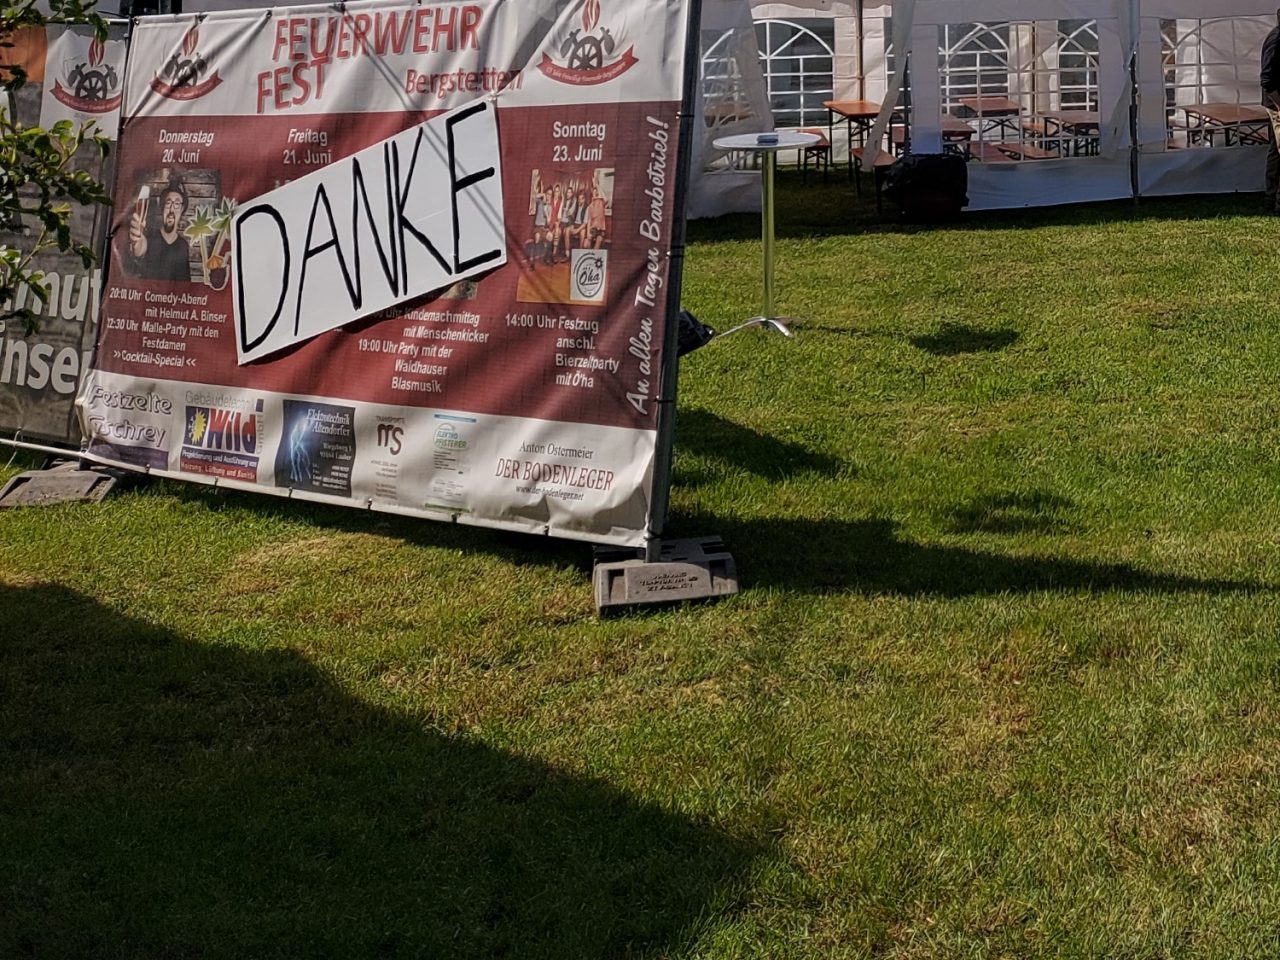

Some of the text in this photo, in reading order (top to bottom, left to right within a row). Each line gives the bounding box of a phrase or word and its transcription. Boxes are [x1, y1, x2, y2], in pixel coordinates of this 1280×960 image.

[272, 5, 485, 62] FEUERWEHR
[257, 56, 332, 114] FEST
[404, 67, 525, 98] Bergstetten
[159, 129, 214, 147] Donnerstag
[287, 128, 328, 145] Freitag
[553, 121, 606, 141] Sonntag
[162, 149, 200, 163] 20. Juni
[283, 150, 332, 165] 21. Juni
[553, 144, 603, 162] 23. Juni
[236, 102, 502, 353] DANKE
[626, 116, 669, 415] An allen Tagen Barbetrieb!
[128, 289, 142, 301] Uhr
[144, 291, 208, 306] Comedy-Abend
[145, 307, 227, 323] mit Helmut A. Binser
[505, 313, 599, 334] 14:00 Uhr Festzug
[126, 319, 139, 331] Uhr
[141, 321, 187, 338] Malle-Party
[189, 327, 203, 337] mit
[204, 328, 219, 338] den
[403, 326, 489, 343] mit Menschenkicker
[142, 337, 186, 351] Festdamen
[358, 339, 453, 358] 19:00 Uhr Party mit der
[556, 336, 596, 350] anschl.
[555, 353, 619, 373] Bierzeltparty
[391, 376, 442, 393] Blasmusik
[556, 373, 572, 386] mit
[89, 385, 173, 415] Festzelte
[207, 408, 257, 454] Wild
[520, 441, 594, 460] Anton Ostermeier
[495, 458, 614, 491] DER BODENLEGER
